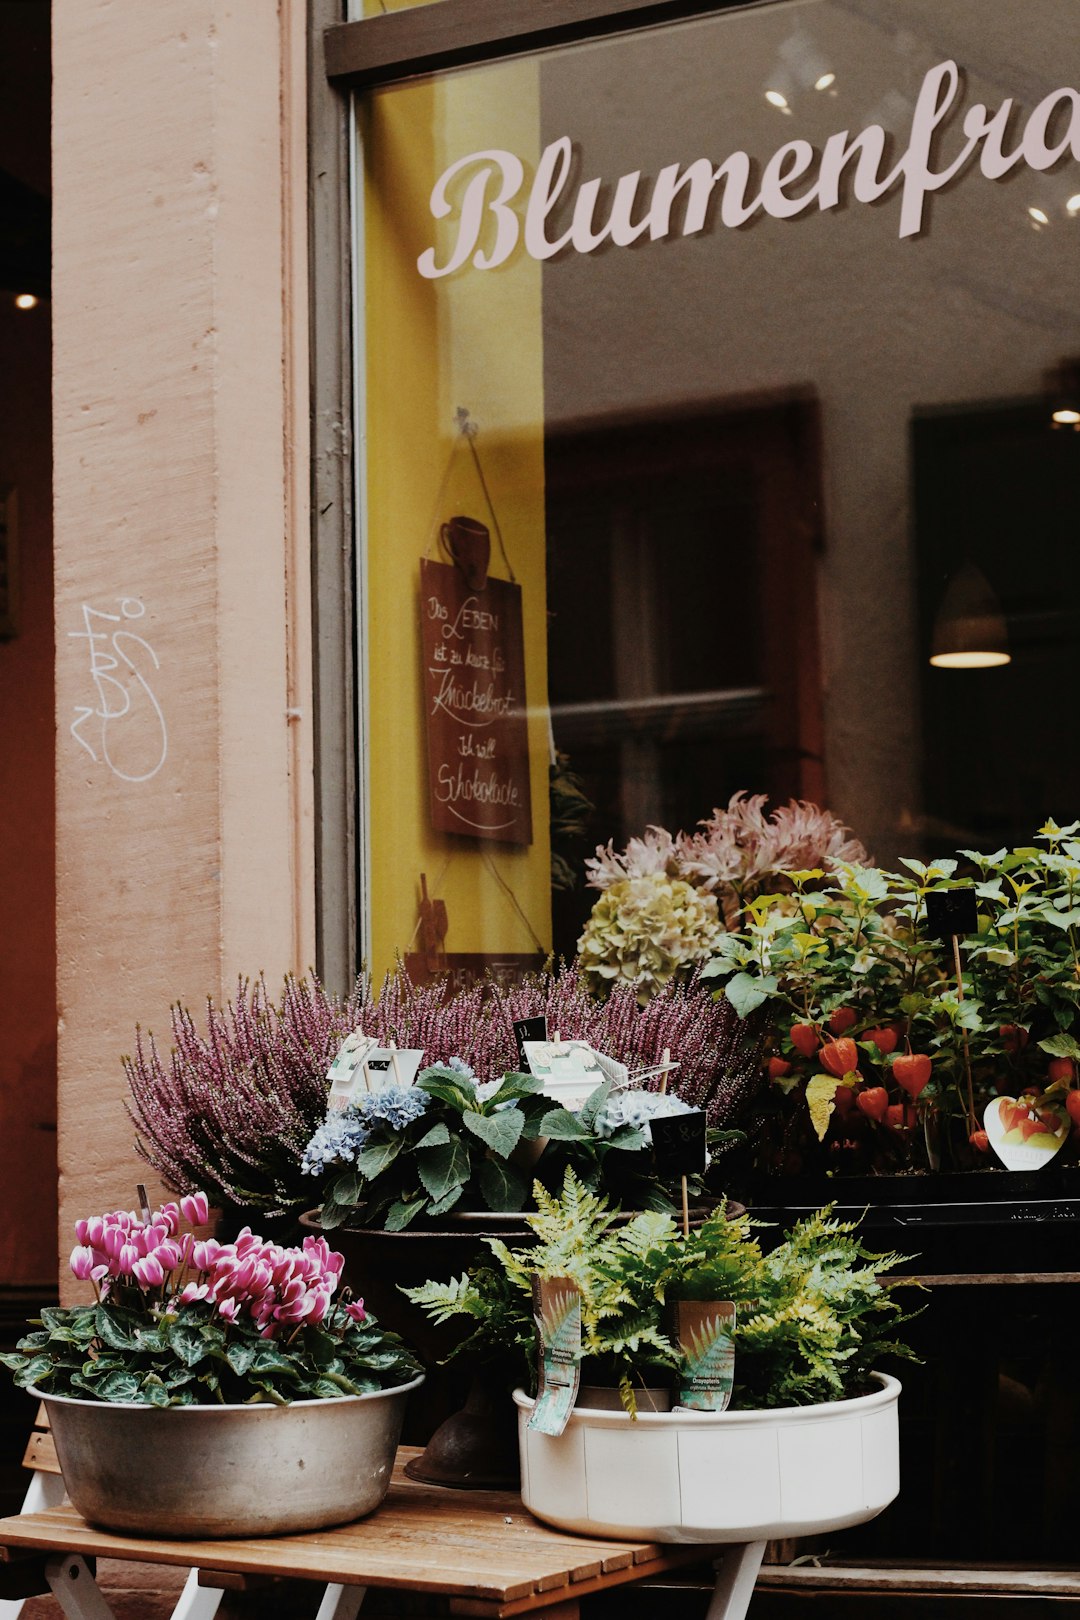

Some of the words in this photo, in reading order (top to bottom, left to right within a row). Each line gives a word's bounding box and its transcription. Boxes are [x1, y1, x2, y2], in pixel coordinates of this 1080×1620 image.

[428, 596, 448, 620] Das
[434, 643, 447, 662] ist
[451, 649, 463, 665] zu
[458, 733, 475, 757] Ich
[476, 737, 496, 759] will
